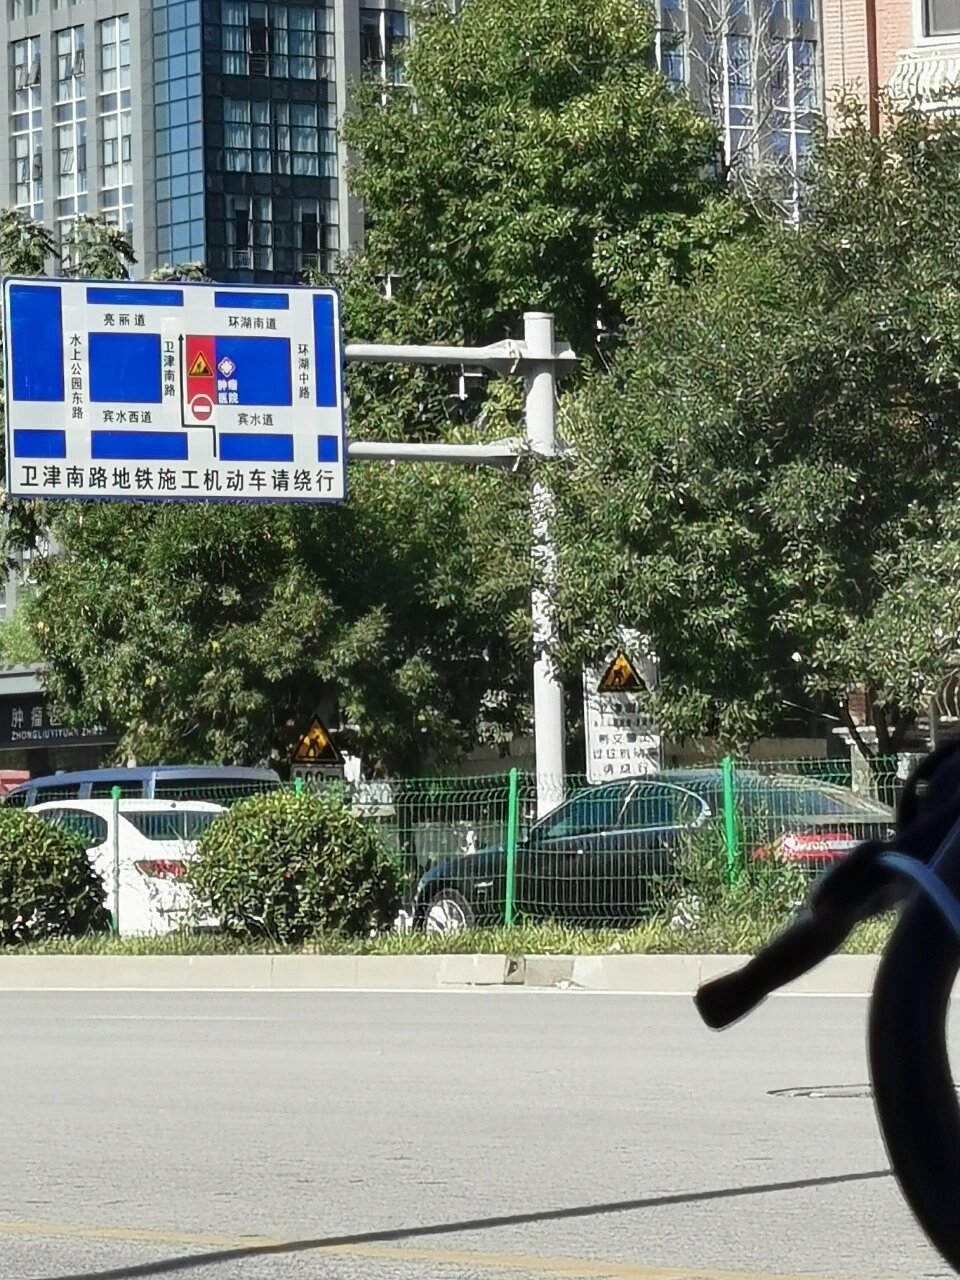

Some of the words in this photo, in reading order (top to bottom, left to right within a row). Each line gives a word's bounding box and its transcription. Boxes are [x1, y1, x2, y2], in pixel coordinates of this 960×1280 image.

[103, 313, 146, 326] 亮丽道
[228, 316, 277, 330] 环湖南道
[70, 333, 83, 420] 水上公园东路
[163, 341, 175, 397] 卫津南路
[298, 344, 310, 399] 环湖中路
[102, 410, 152, 423] 宾水西道
[237, 412, 274, 426] 宾水道
[19, 465, 335, 493] 卫津南路地铁施工机动车请绕行
